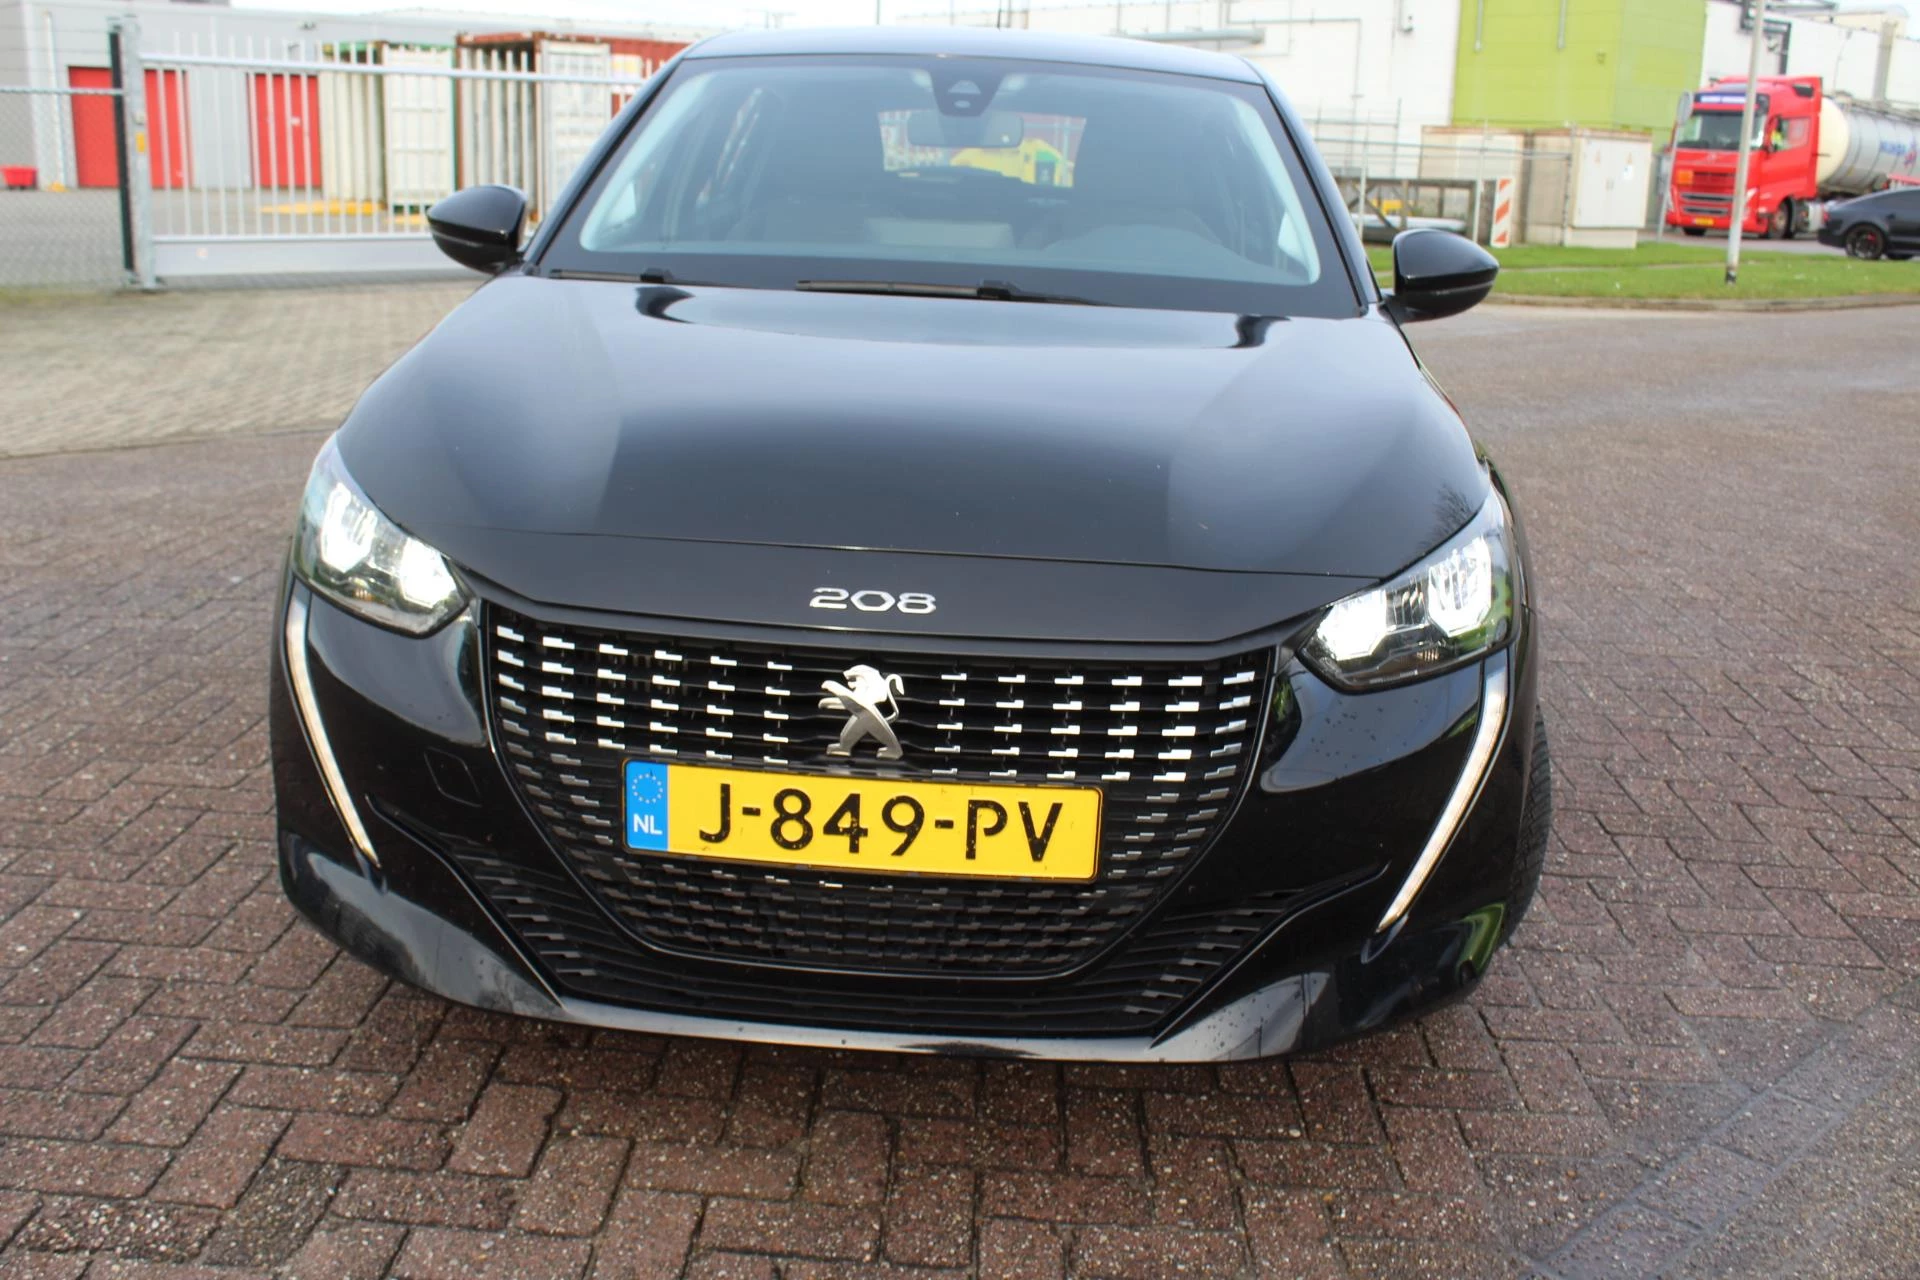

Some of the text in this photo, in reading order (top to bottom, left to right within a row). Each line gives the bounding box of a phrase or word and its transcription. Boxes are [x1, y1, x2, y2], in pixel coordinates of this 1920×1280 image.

[809, 587, 937, 614] 208
[633, 813, 663, 835] NL
[699, 783, 1063, 862] J-849-PV
